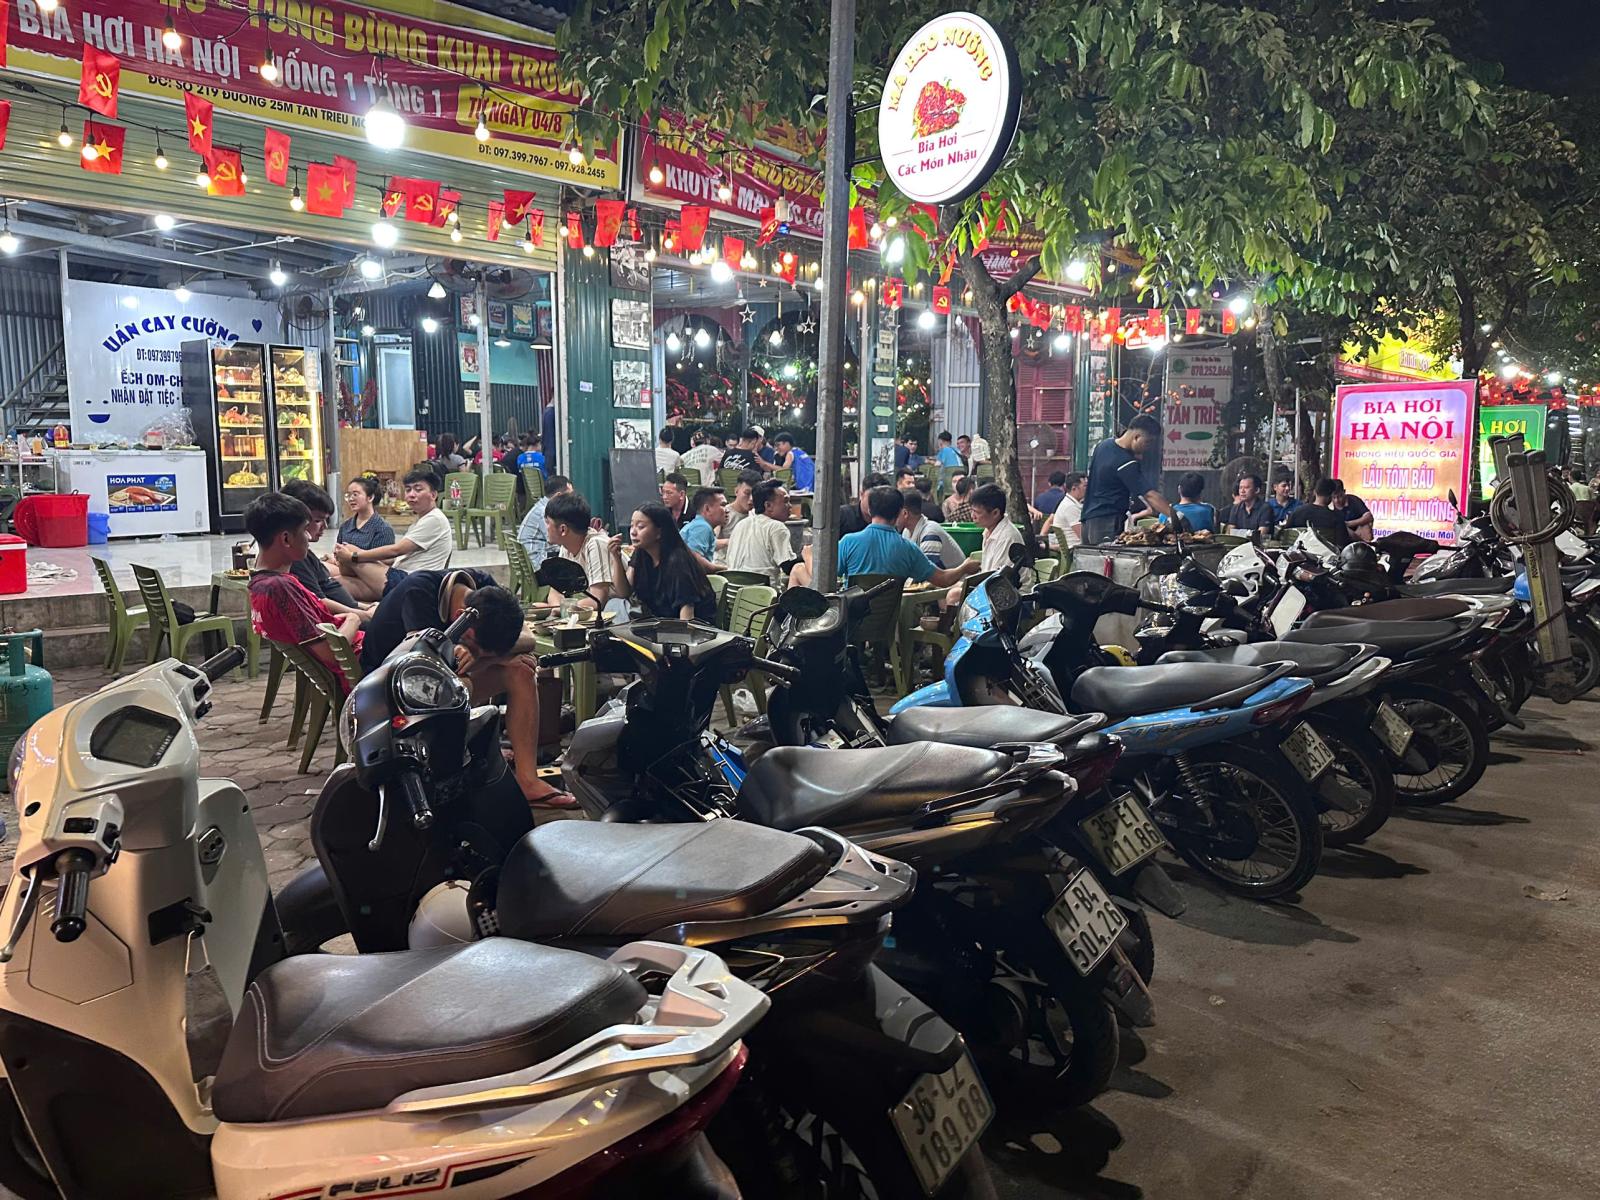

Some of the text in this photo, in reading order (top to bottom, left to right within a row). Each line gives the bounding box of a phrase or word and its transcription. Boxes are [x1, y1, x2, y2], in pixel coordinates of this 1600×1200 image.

[17, 0, 75, 43] BIA
[82, 12, 136, 57] HƠI
[193, 36, 241, 85] NỘI
[344, 72, 356, 102] 1
[432, 90, 443, 118] 1
[344, 11, 428, 68] BỪNG
[437, 35, 502, 82] KHAI
[197, 84, 218, 97] 219
[270, 99, 293, 113] 25M
[532, 111, 562, 133] 04/8
[479, 144, 491, 154] ĐT:
[494, 147, 548, 166] 097.399.7967
[555, 160, 605, 178] 097.928.2455
[918, 140, 934, 154] Bia
[898, 149, 976, 177] Các Món Nhậu
[141, 315, 175, 334] CAY
[111, 387, 135, 405] NHẬN
[139, 388, 153, 406] ĐẶT
[157, 388, 174, 407] TIỆC
[1364, 397, 1442, 415] BIA HƠI
[1350, 417, 1390, 440] HÀ
[1400, 416, 1454, 444] NỘI
[1490, 419, 1527, 434] HƠI
[1439, 450, 1457, 458] GIA
[1385, 464, 1409, 489] TÔM
[1091, 801, 1139, 840] 35-E1
[1104, 822, 1160, 867] 011.86
[1068, 901, 1122, 967] 504.26
[920, 1083, 988, 1181] 189.88
[328, 1169, 440, 1197] FELIZ
